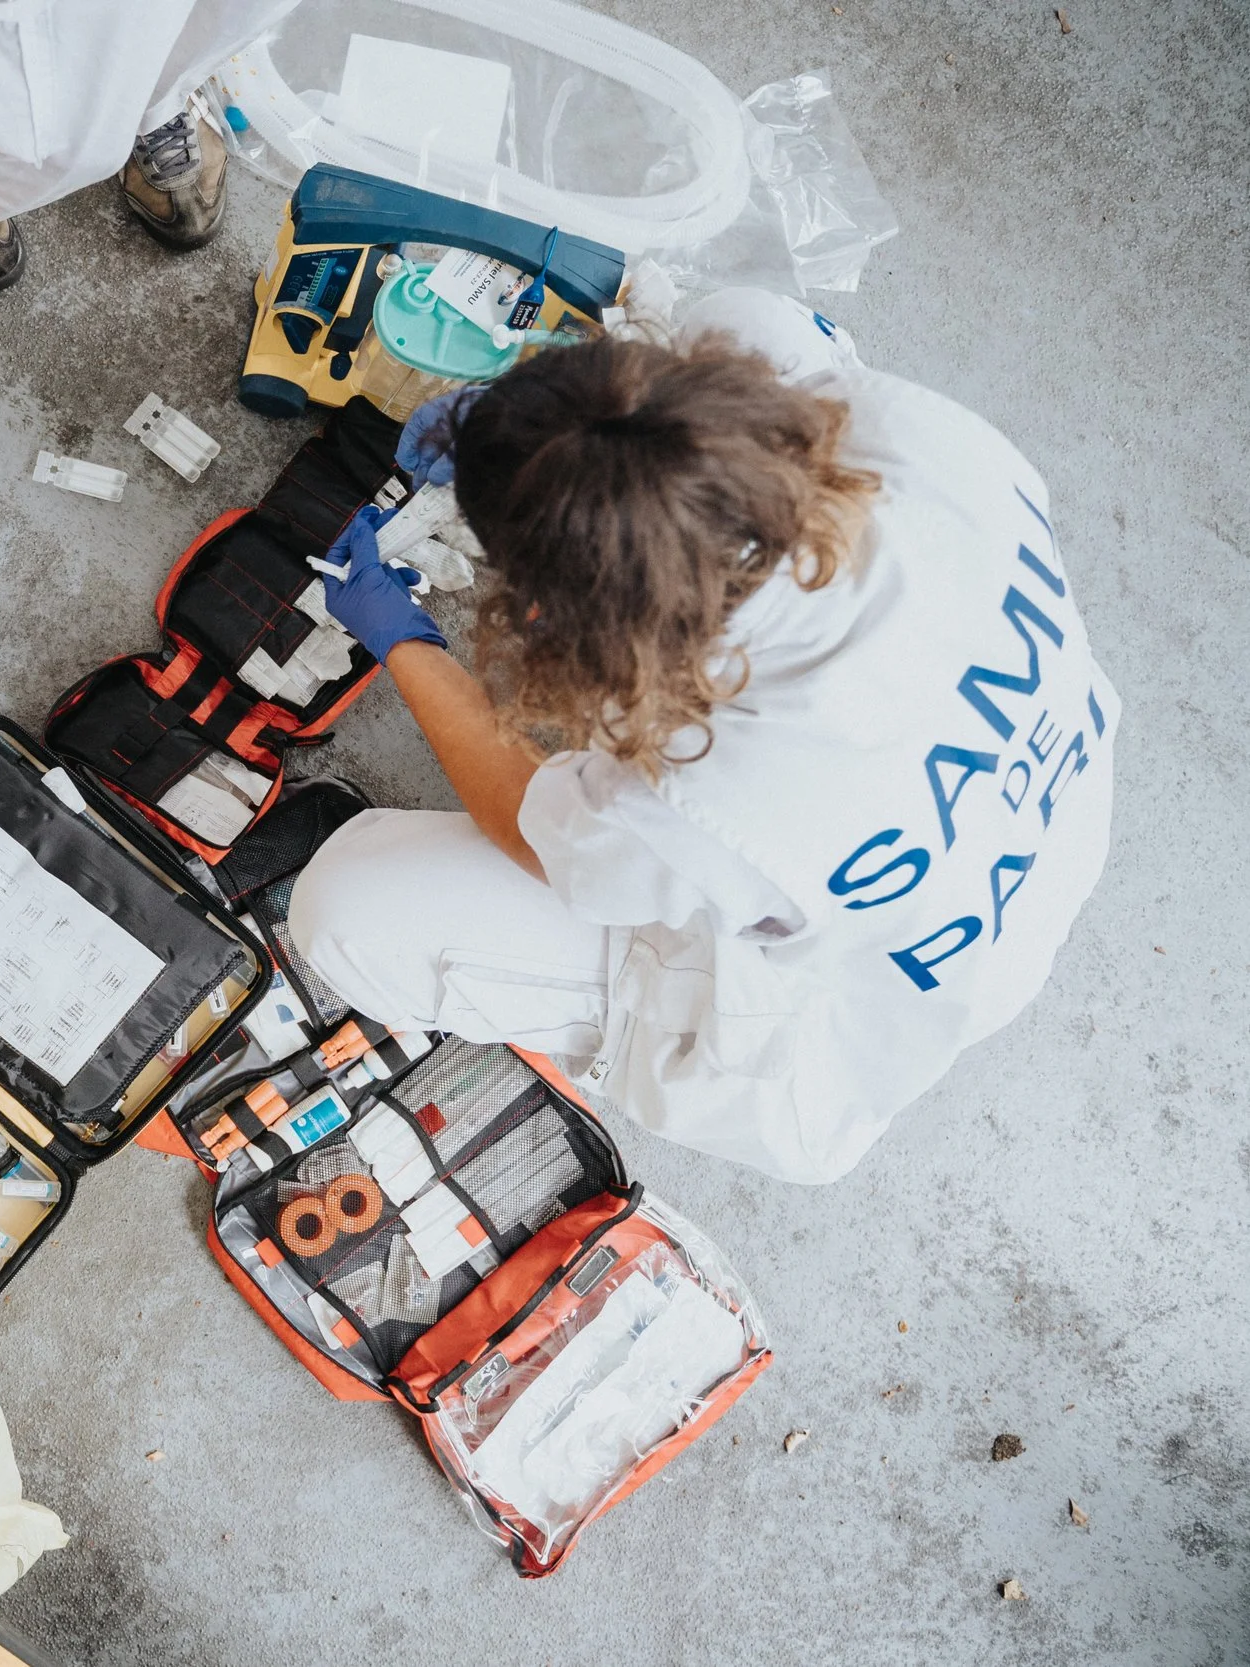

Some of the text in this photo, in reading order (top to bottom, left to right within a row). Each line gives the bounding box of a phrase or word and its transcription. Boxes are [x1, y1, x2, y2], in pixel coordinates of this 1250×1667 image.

[466, 277, 491, 305] SAMU
[828, 484, 1066, 910] SAMU
[1001, 709, 1062, 814] DE
